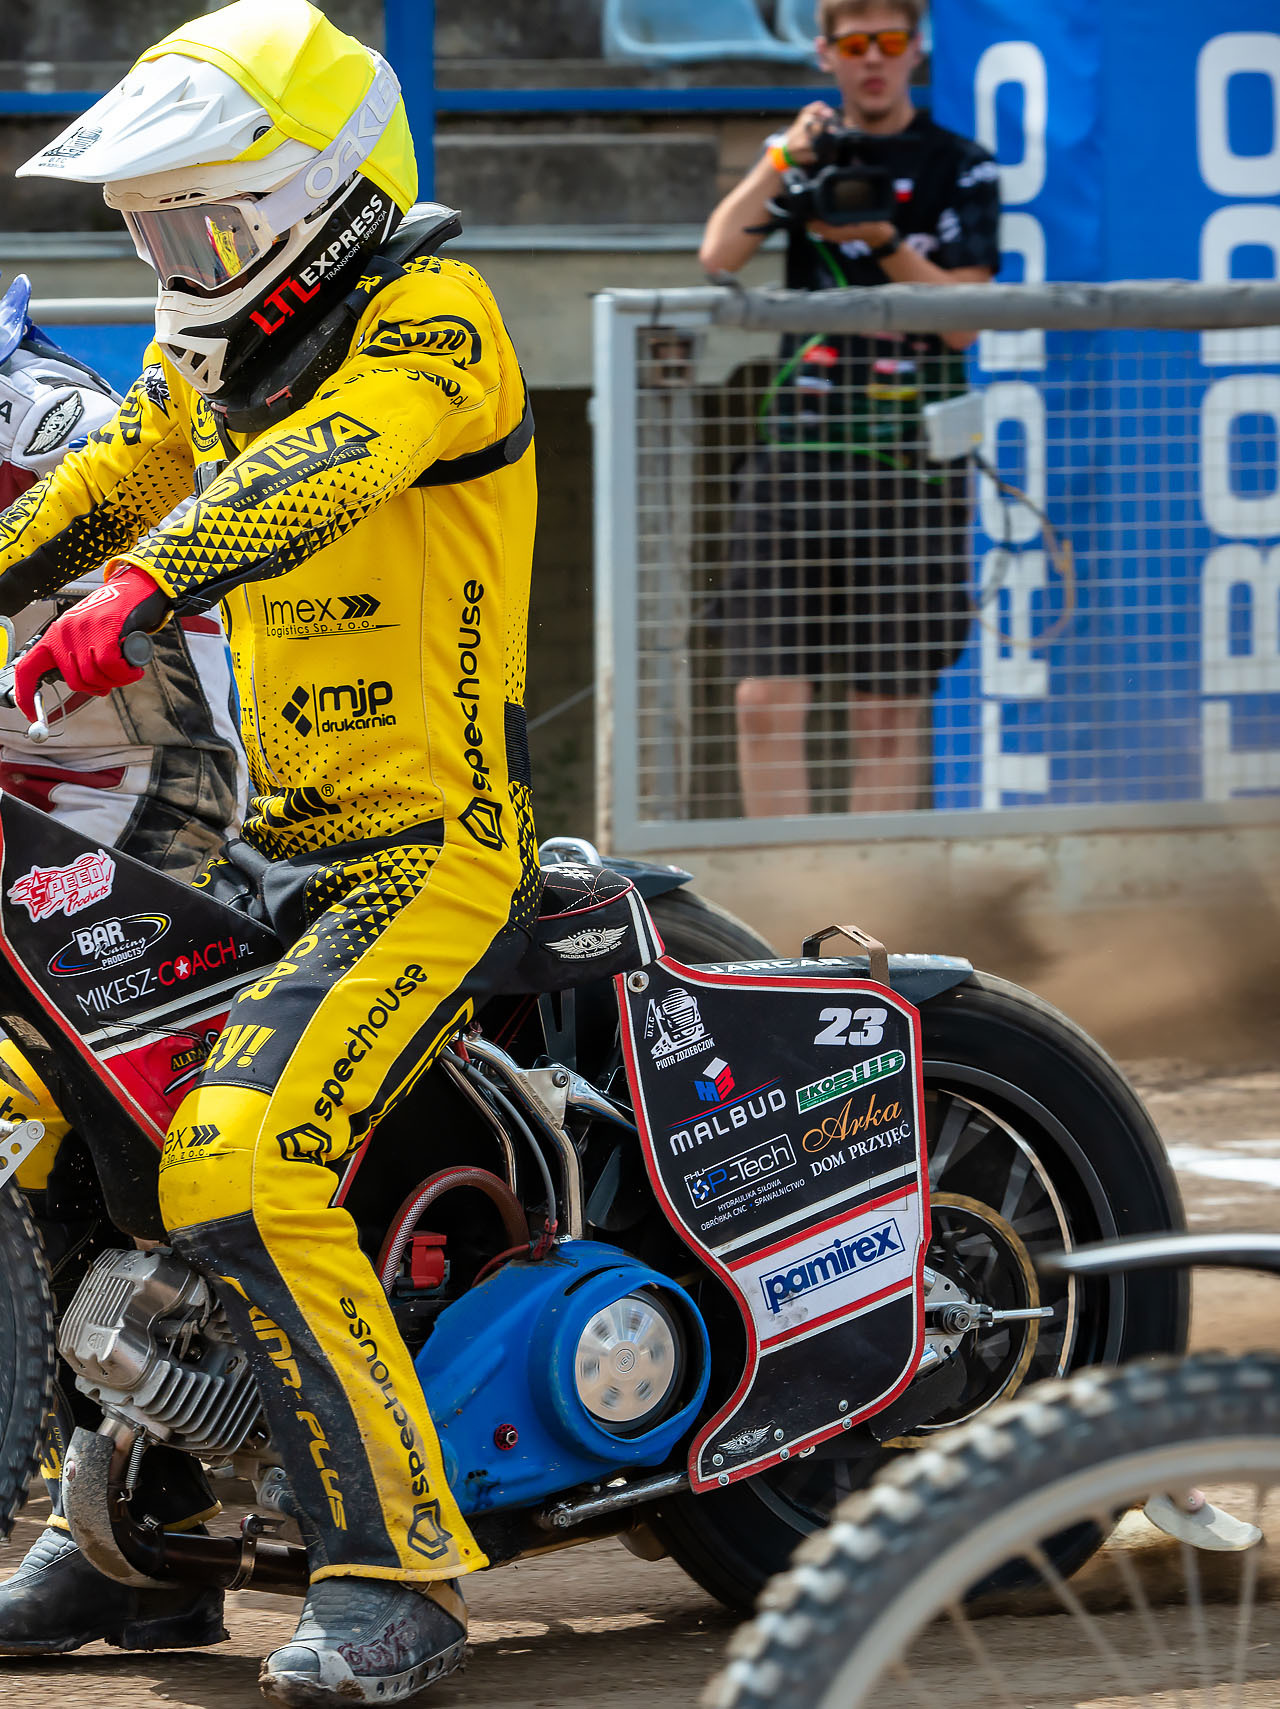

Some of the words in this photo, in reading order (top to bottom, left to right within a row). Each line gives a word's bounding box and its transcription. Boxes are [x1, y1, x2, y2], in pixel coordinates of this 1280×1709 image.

[249, 276, 320, 336] LTL
[299, 194, 384, 287] EXPRESS
[324, 244, 361, 282] TRANSPORT
[200, 413, 376, 504] SALVA
[233, 494, 259, 509] OKNA
[261, 476, 294, 495] DRZWI
[261, 593, 338, 626] Imex
[266, 625, 310, 639] Logistics
[313, 622, 333, 634] Sp.
[337, 622, 344, 631] z
[347, 620, 376, 630] o.o.
[318, 678, 394, 718] mjp
[452, 579, 493, 793] spechouse
[321, 713, 397, 733] drukarnia
[29, 862, 106, 907] SPEED
[64, 884, 109, 913] Products
[76, 921, 126, 956] BAR
[94, 936, 147, 960] Racing
[101, 948, 144, 967] PRODUCTS
[314, 962, 428, 1122] spechouse
[813, 1007, 888, 1046] 23
[655, 1054, 676, 1071] PIOTR
[165, 1126, 189, 1155] ex
[669, 1089, 787, 1156] MALBUD
[802, 1094, 903, 1153] Arka
[809, 1151, 847, 1177] DOM
[847, 1119, 912, 1160] PRZYJĘĆ
[707, 1145, 791, 1194] P-Tech
[700, 1212, 733, 1231] OBRÓBKA
[732, 1204, 748, 1216] CNC
[754, 1178, 806, 1207] SPAWALNICTWO
[717, 1190, 758, 1212] HYDRAULIKA
[757, 1179, 782, 1195] SIŁOWA
[765, 1225, 900, 1314] pamirex
[339, 1296, 431, 1498] spechouse
